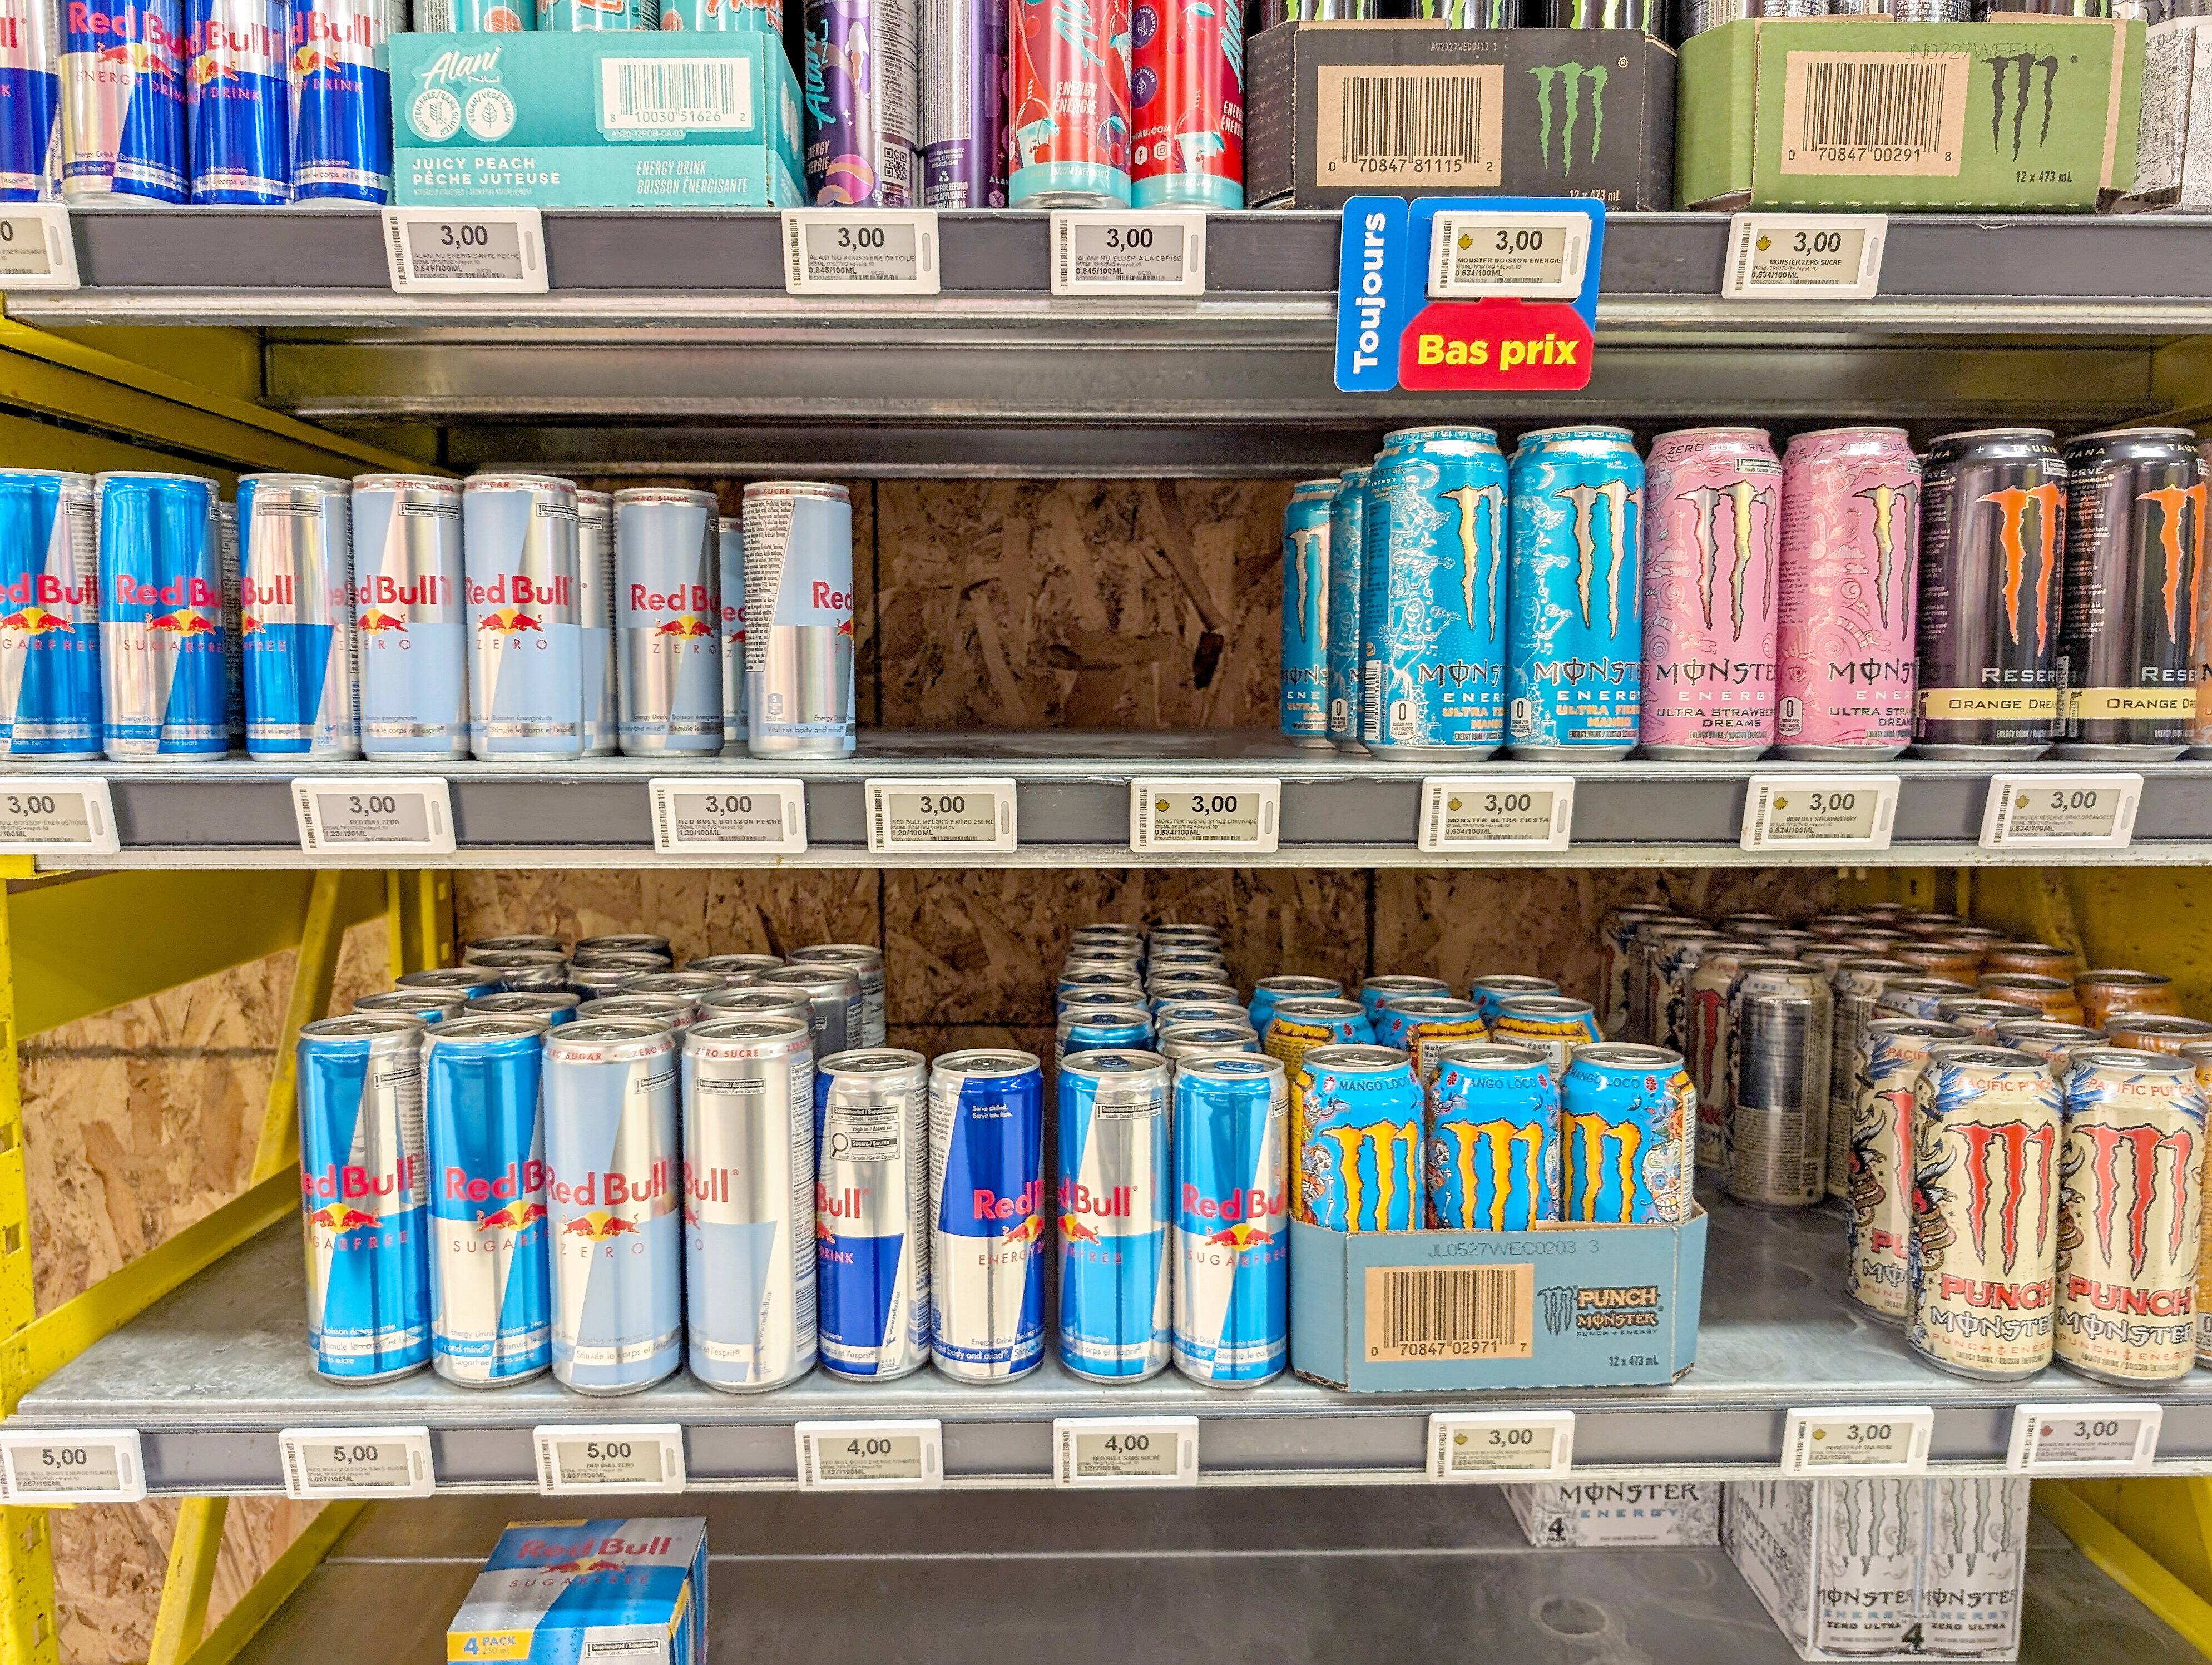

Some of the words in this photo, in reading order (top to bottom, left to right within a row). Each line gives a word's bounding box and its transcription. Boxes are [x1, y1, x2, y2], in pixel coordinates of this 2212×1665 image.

[68, 2, 137, 36] Red
[308, 11, 374, 47] Bull
[421, 46, 501, 90] Alani
[212, 86, 260, 101] DRINK
[313, 78, 364, 94] DRINK
[1056, 81, 1097, 97] ENERGY
[1053, 97, 1096, 115] ÉNERGIE
[610, 113, 616, 122] 8
[635, 112, 675, 122] 10030
[680, 112, 721, 122] 51626
[740, 113, 745, 122] 2
[413, 158, 466, 170] JUICY
[475, 157, 535, 170] PEACH
[1788, 151, 1795, 160] 0
[1818, 148, 1865, 161] 70847
[1873, 148, 1920, 161] 00291
[1945, 152, 1952, 161] 8
[637, 161, 674, 176] ENERGY
[677, 161, 706, 175] DRINK
[1328, 162, 1335, 171] 0
[1359, 159, 1407, 172] 70847
[1414, 159, 1462, 172] 81115
[1486, 162, 1493, 171] 2
[413, 170, 472, 184] PÊCHE
[479, 172, 560, 184] JUTEUSE
[637, 179, 680, 194] BOISSON
[683, 176, 748, 194] ÉNERGISANTE
[2016, 171, 2026, 183] 12
[2029, 174, 2036, 183] x
[2038, 170, 2056, 183] 473
[2058, 170, 2072, 182] mL
[441, 225, 488, 250] 3,00
[838, 227, 884, 251] 3,00
[1107, 228, 1152, 252] 3,00
[1496, 231, 1542, 254] 3,00
[1794, 232, 1841, 256] 3,00
[1353, 212, 1385, 374] Toujours
[1418, 334, 1488, 365] Bas
[1500, 334, 1578, 371] prix
[117, 574, 184, 604] Red
[377, 575, 437, 606] Bull
[466, 574, 505, 604] Red
[512, 576, 569, 606] Bull
[631, 584, 686, 611] Red
[812, 581, 853, 611] Red
[477, 639, 547, 650] ZERO
[653, 643, 716, 654] ZERO
[1656, 658, 1775, 686] MONSTE
[1399, 703, 1406, 721] 0
[1443, 707, 1489, 717] ULTRA
[1517, 701, 1523, 718] 0
[1557, 705, 1609, 715] ULTRA
[1786, 700, 1793, 716] 0
[1830, 707, 1881, 716] ULTRA
[1949, 698, 2022, 710] ORANGE
[2107, 698, 2177, 708] ORANGE
[1657, 708, 1704, 717] ULTRA
[8, 796, 55, 817] 3,00
[349, 796, 395, 816] 3,00
[706, 795, 752, 816] 3,00
[920, 796, 965, 816] 3,00
[1192, 795, 1237, 816] 3,00
[1484, 794, 1531, 815] 3,00
[1809, 793, 1855, 814] 3,00
[2051, 791, 2097, 812] 3,00
[566, 1052, 602, 1061] SUGAR
[633, 1047, 656, 1057] ZÉRO
[695, 1047, 718, 1058] ZÉRO
[724, 1048, 759, 1058] SUCRE
[1339, 1080, 1382, 1091] MANGO
[1387, 1076, 1410, 1089] LOCO
[1507, 1077, 1537, 1089] LOCO
[1606, 1077, 1640, 1089] LOCO
[446, 1162, 517, 1201] Red
[546, 1170, 595, 1206] Red
[604, 1160, 667, 1206] Bull
[973, 1181, 1032, 1220] Red
[1074, 1185, 1130, 1217] Bull
[1183, 1186, 1240, 1220] Red
[560, 1242, 645, 1258] ZERO
[1428, 1241, 1577, 1258] JL0527WEC0203
[1589, 1240, 1599, 1253] 3
[1577, 1286, 1657, 1309] PUNCH
[1941, 1273, 2053, 1309] PUNCH
[2067, 1272, 2193, 1317] PUNCH
[1576, 1311, 1658, 1329] MONSTER
[972, 1338, 993, 1346] Energy
[1371, 1347, 1378, 1356] 0
[1400, 1343, 1446, 1356] 70847
[1452, 1342, 1498, 1355] 02971
[1521, 1343, 1527, 1352] 7
[455, 1358, 489, 1366] Sugarfree
[576, 1350, 603, 1361] Stimule
[606, 1350, 615, 1360] le
[618, 1348, 641, 1360] corps
[644, 1346, 651, 1355] et
[1610, 1357, 1619, 1367] 12
[1629, 1355, 1644, 1367] 473
[1646, 1355, 1659, 1366] mL
[1489, 1429, 1533, 1447] 3,00
[1847, 1425, 1891, 1443] 3,00
[2074, 1421, 2118, 1439] 3,00
[587, 1443, 631, 1461] 5,00
[847, 1439, 892, 1457] 4,00
[1105, 1435, 1149, 1453] 4,00
[43, 1449, 87, 1468] 5,00
[334, 1446, 378, 1464] 5,00
[1560, 1482, 1699, 1505] MONSTER
[1548, 1517, 1565, 1535] 4
[517, 1538, 595, 1559] Red
[597, 1537, 672, 1555] Bull
[1902, 1622, 1924, 1648] 4
[464, 1637, 480, 1655] 4
[483, 1636, 516, 1647] PACK
